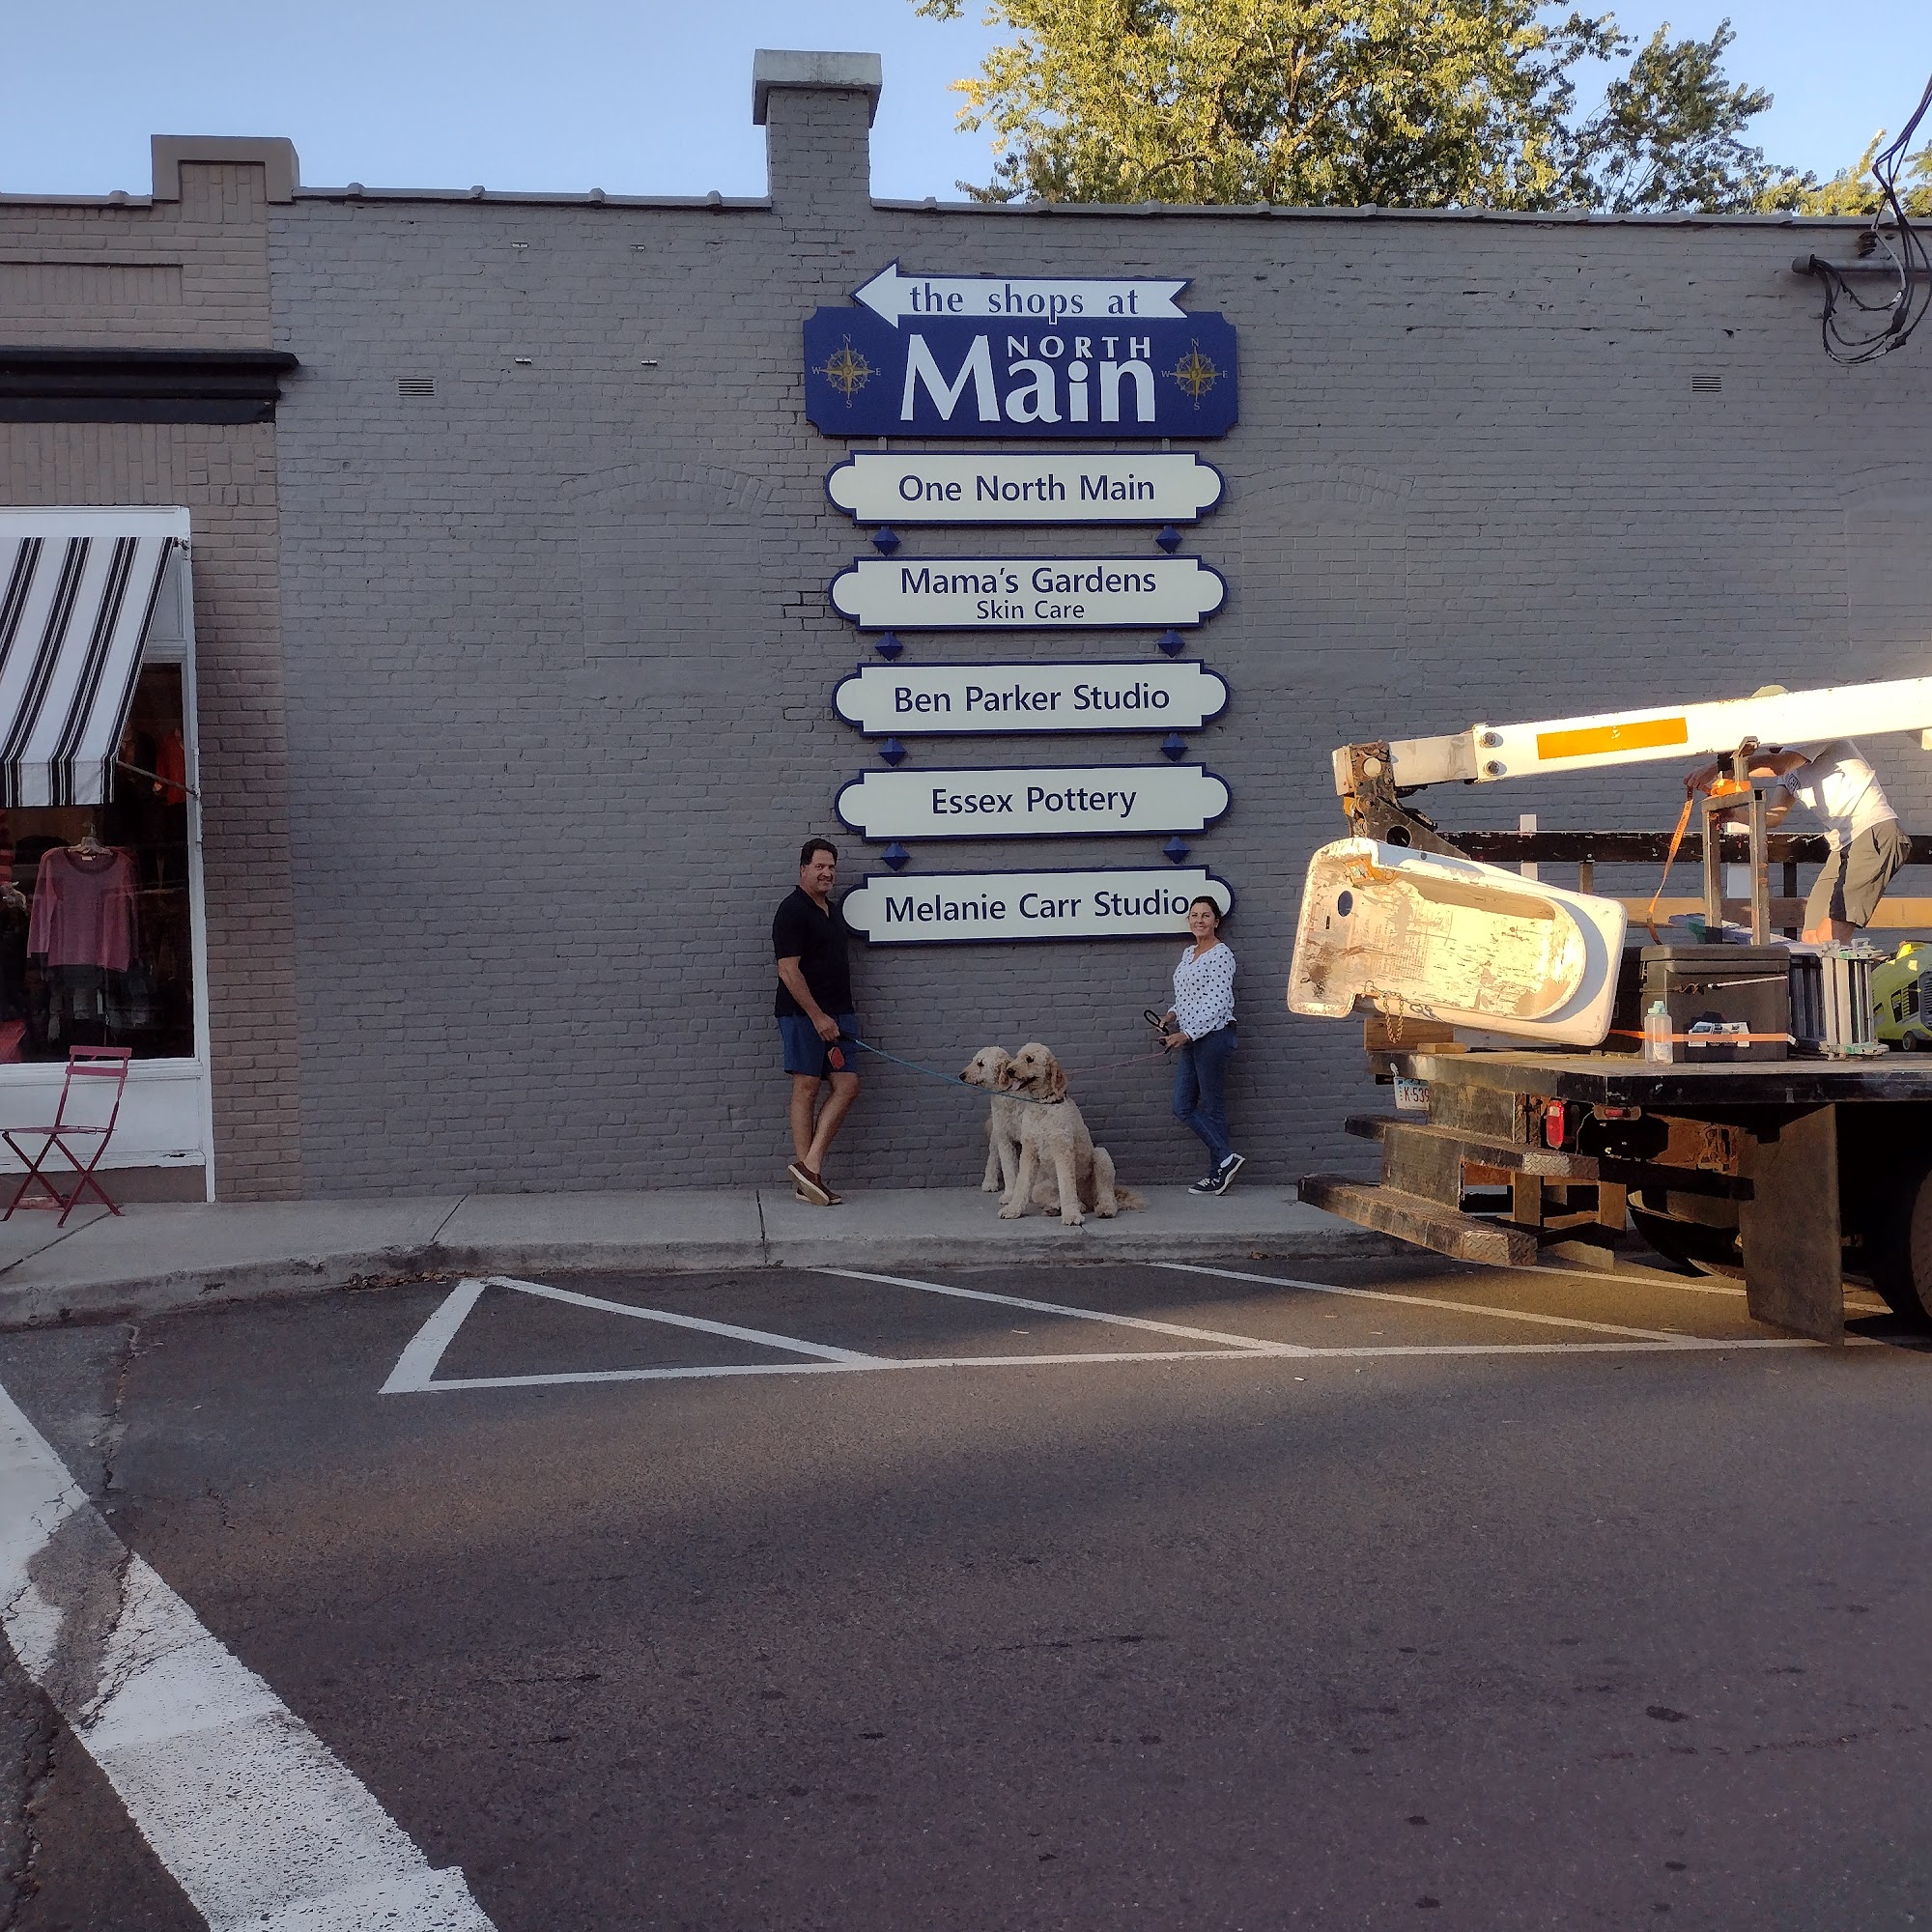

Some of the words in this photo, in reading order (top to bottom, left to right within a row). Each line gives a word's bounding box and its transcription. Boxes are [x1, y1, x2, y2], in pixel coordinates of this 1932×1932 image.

[909, 282, 964, 313] the
[988, 283, 1084, 325] shops
[1108, 289, 1139, 315] at
[842, 333, 851, 343] N
[1007, 335, 1151, 358] NORTH
[1191, 337, 1199, 347] N
[811, 366, 821, 375] W
[875, 367, 882, 376] E
[899, 333, 1156, 424] Main
[845, 399, 853, 409] S
[1193, 402, 1201, 411] S
[898, 474, 962, 501] One
[976, 473, 1065, 501] North
[1079, 473, 1154, 501] Main
[901, 567, 1019, 594] Mama's
[1032, 565, 1156, 594] Gardens
[977, 599, 1024, 620] Skin
[1035, 600, 1085, 619] Care
[895, 687, 952, 713] Ben
[965, 684, 1062, 712] Parker
[1073, 682, 1170, 711] Studio
[932, 788, 1013, 814] Essex
[1027, 786, 1137, 818] Pottery
[885, 893, 1007, 923] Melanie
[1019, 893, 1082, 919] Carr
[1094, 888, 1189, 917] Studio
